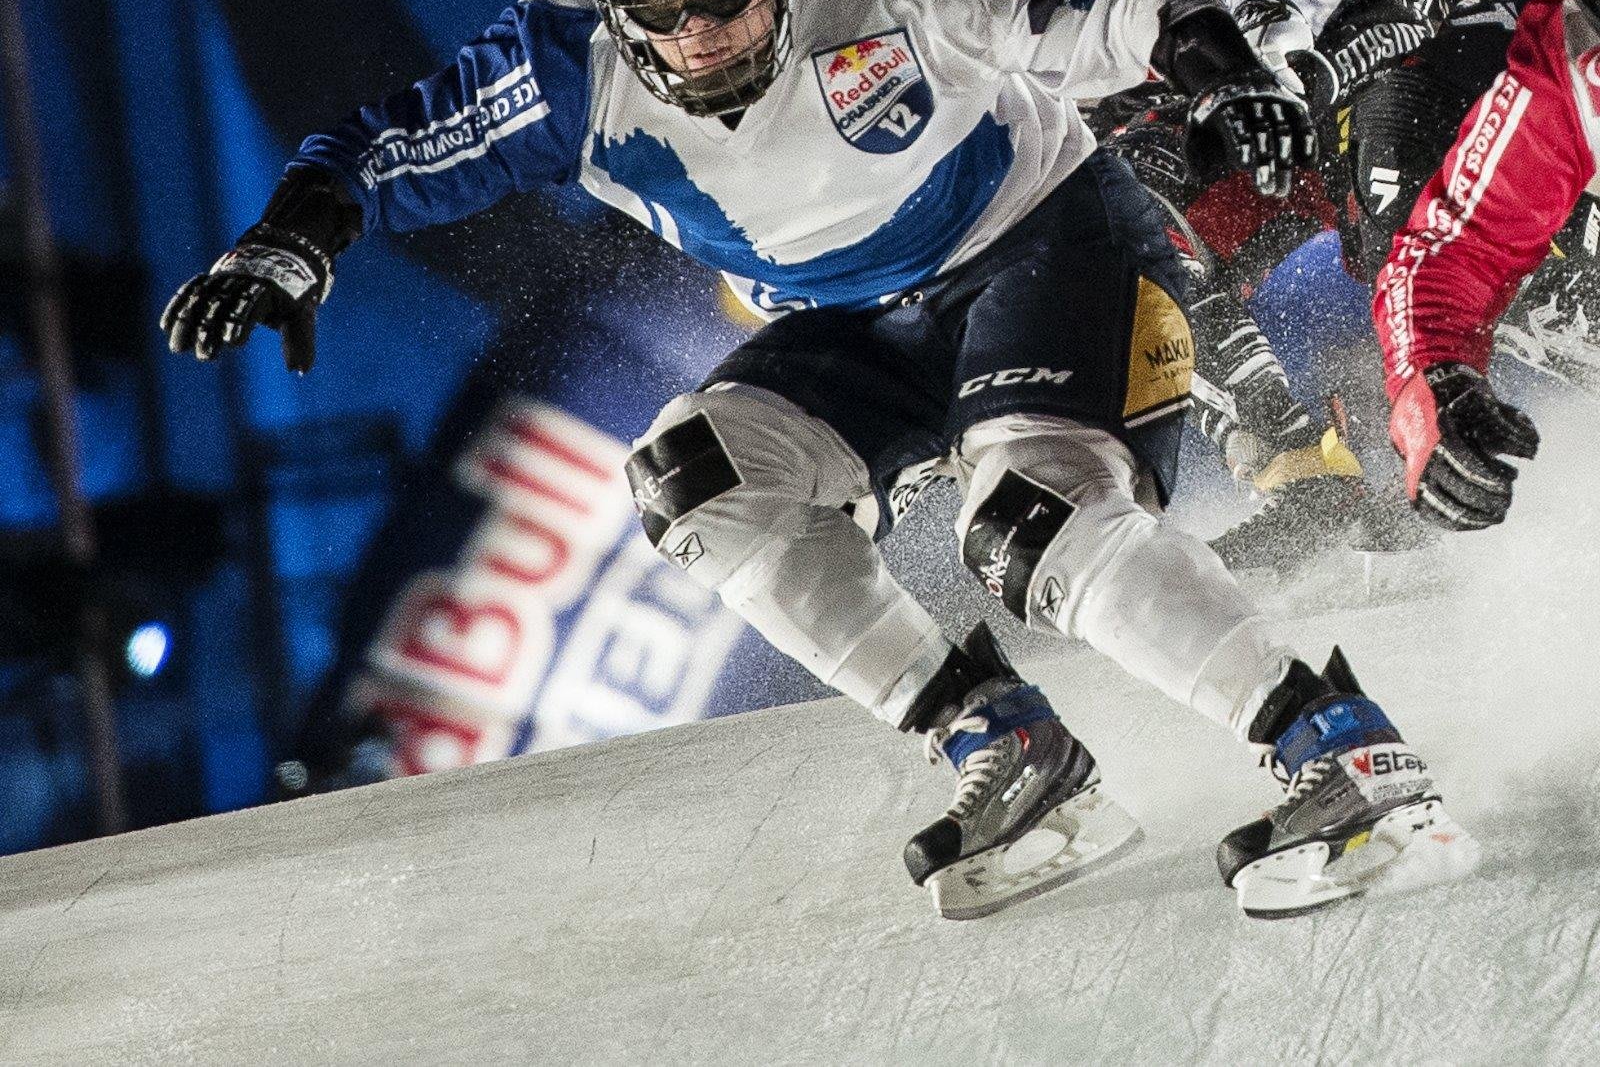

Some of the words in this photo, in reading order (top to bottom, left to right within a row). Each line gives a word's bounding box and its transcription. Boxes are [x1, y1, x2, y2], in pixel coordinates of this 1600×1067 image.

[512, 76, 542, 106] ICE
[831, 73, 873, 110] Red
[868, 47, 910, 81] Bull
[1498, 75, 1519, 110] ICE
[837, 76, 900, 130] CRASHED
[957, 366, 1073, 399] CCM
[393, 414, 622, 688] Bull
